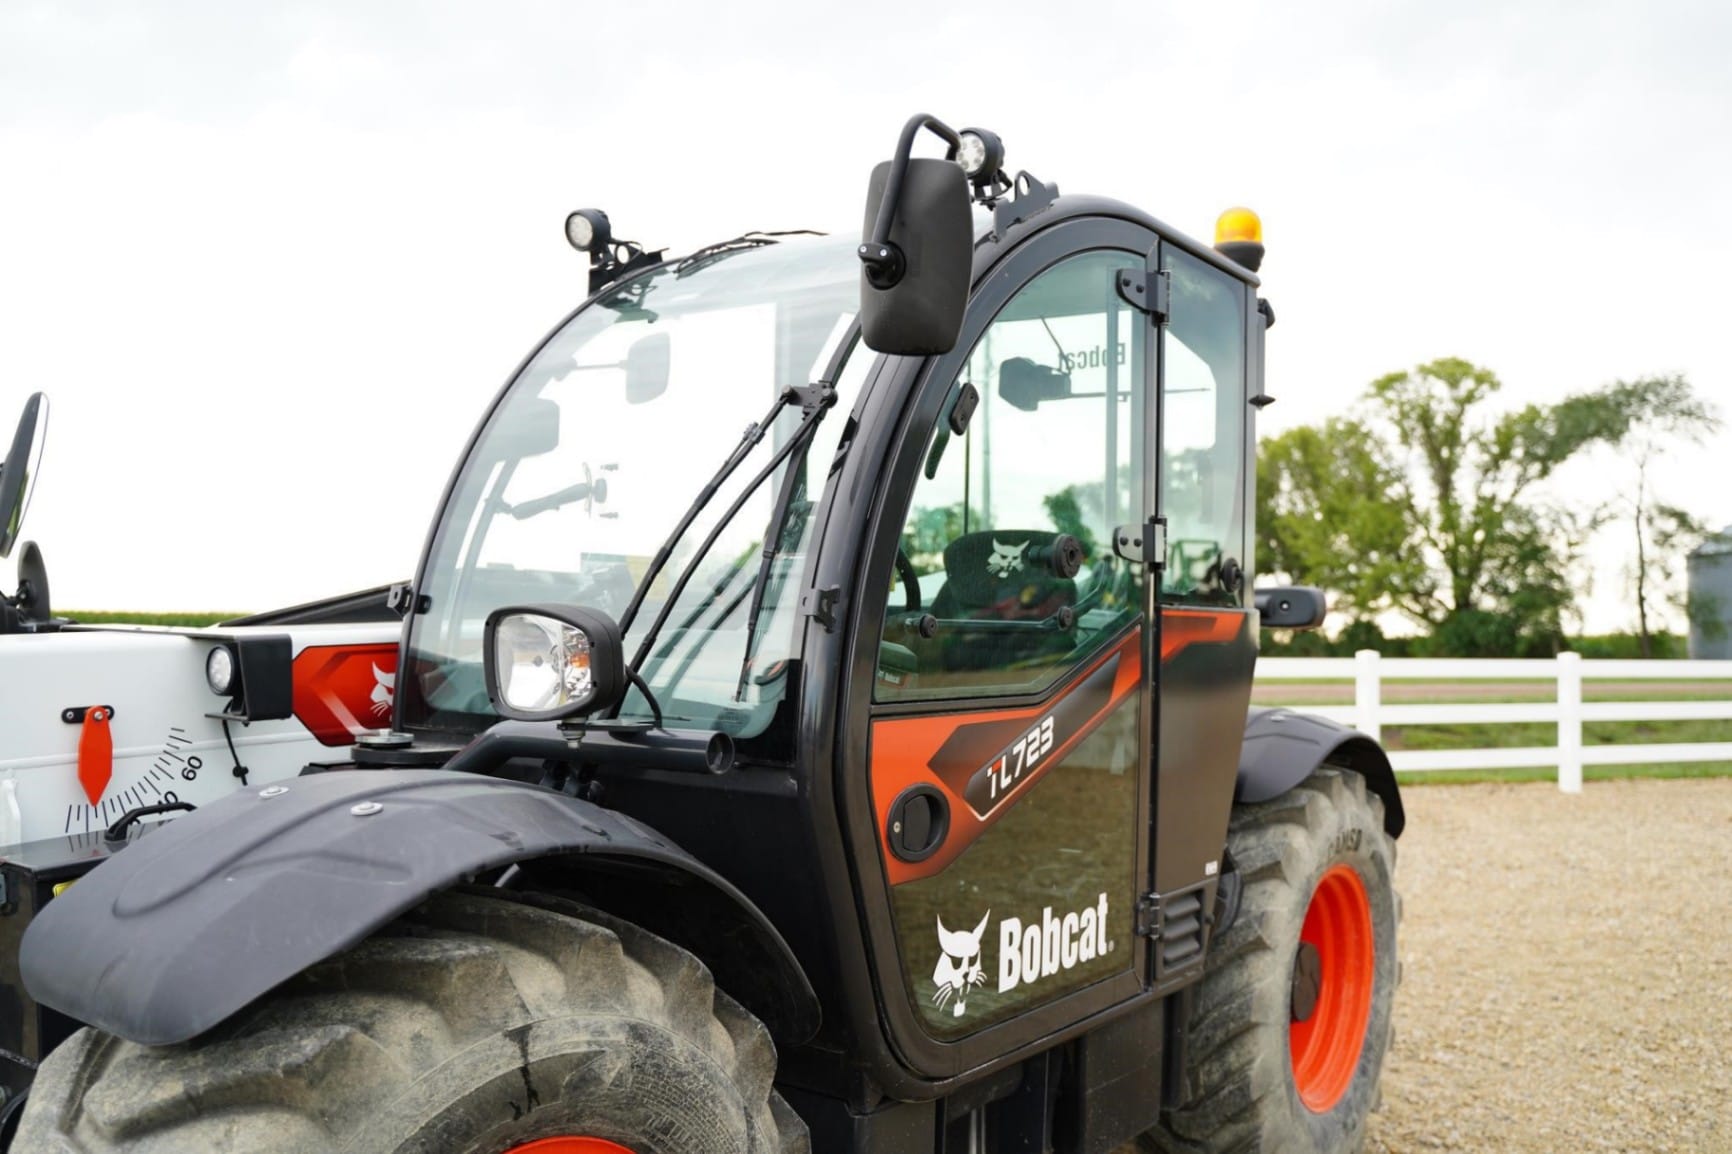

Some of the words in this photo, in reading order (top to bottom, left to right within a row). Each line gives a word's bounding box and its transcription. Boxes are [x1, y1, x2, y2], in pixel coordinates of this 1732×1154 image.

[181, 755, 203, 781] 60
[987, 715, 1054, 799] TL723
[998, 892, 1108, 994] Bobcat
